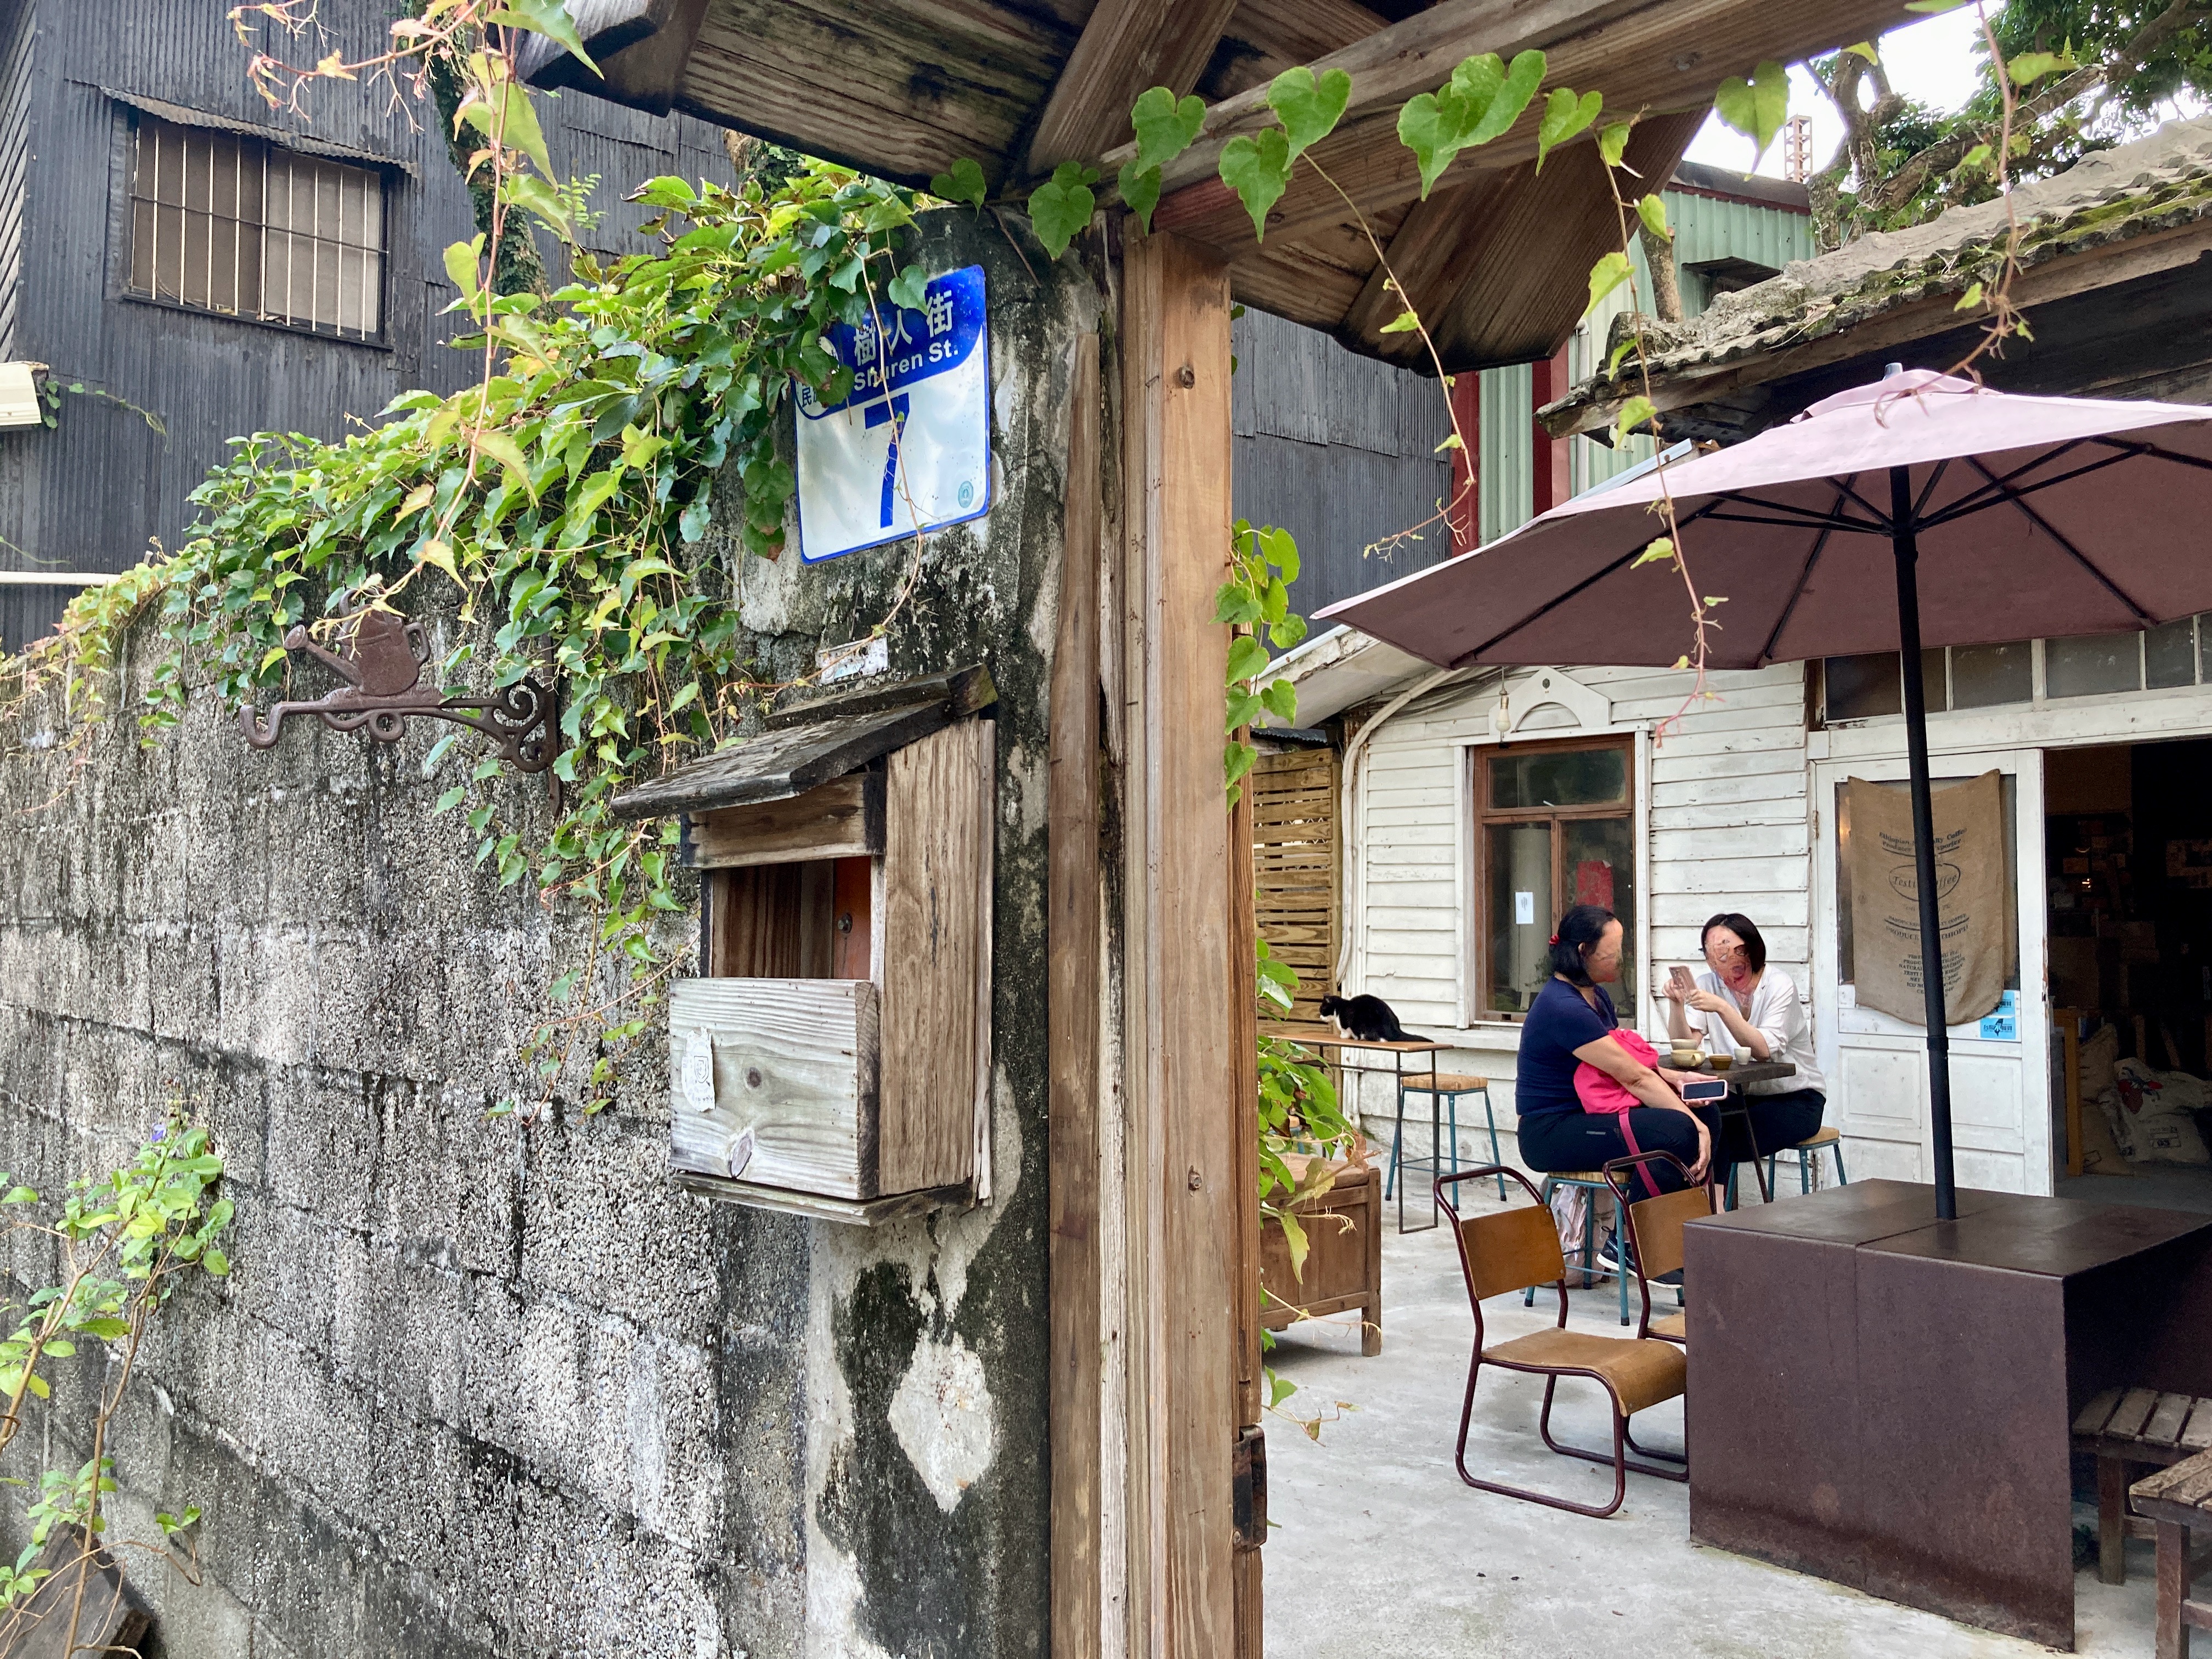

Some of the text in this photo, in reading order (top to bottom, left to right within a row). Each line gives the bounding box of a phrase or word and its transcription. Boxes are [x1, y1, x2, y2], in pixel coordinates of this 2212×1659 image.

[854, 290, 953, 366] 樹人街
[854, 338, 959, 391] Shuren St.
[865, 392, 910, 529] 7
